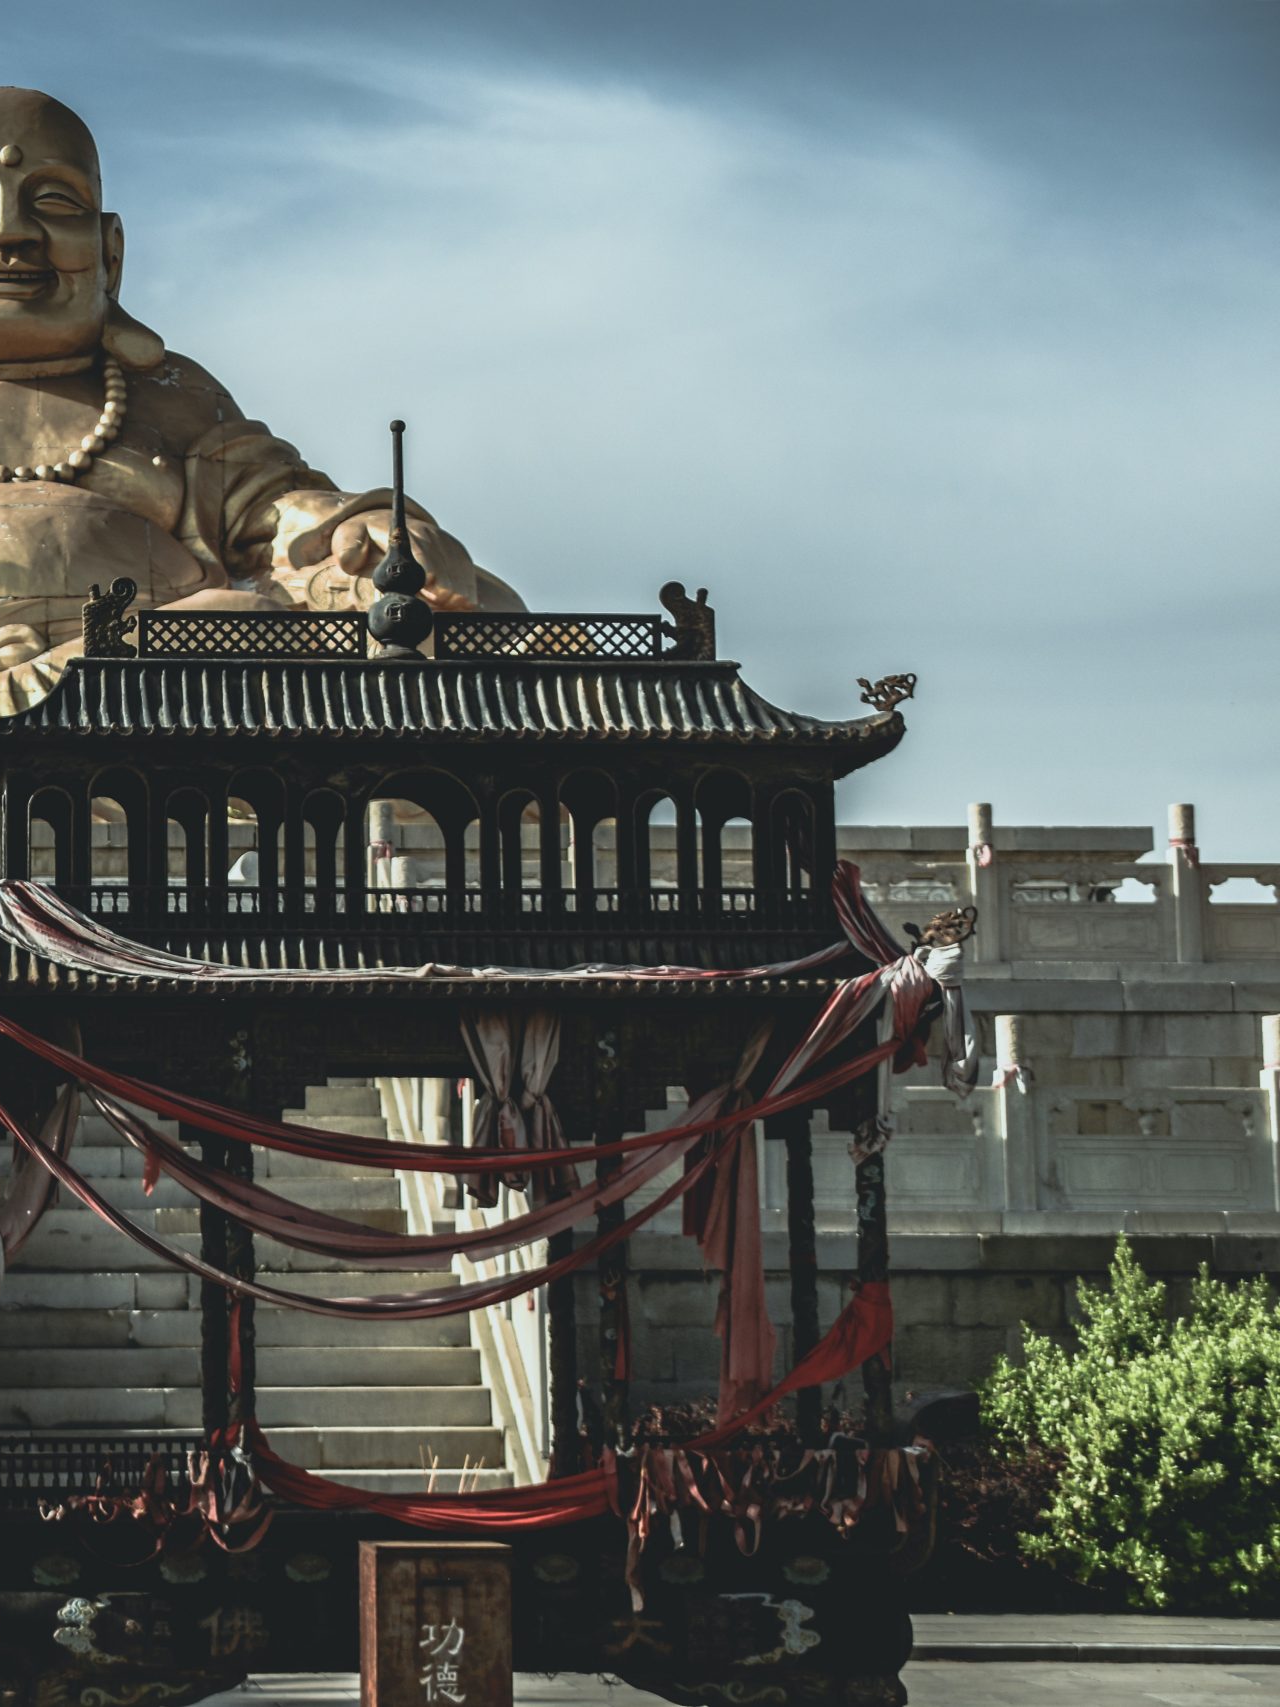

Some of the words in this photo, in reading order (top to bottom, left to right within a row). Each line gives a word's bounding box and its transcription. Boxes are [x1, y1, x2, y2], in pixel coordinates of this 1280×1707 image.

[199, 1607, 269, 1658] 佛
[603, 1609, 673, 1656] 大
[418, 1617, 467, 1703] 功德
